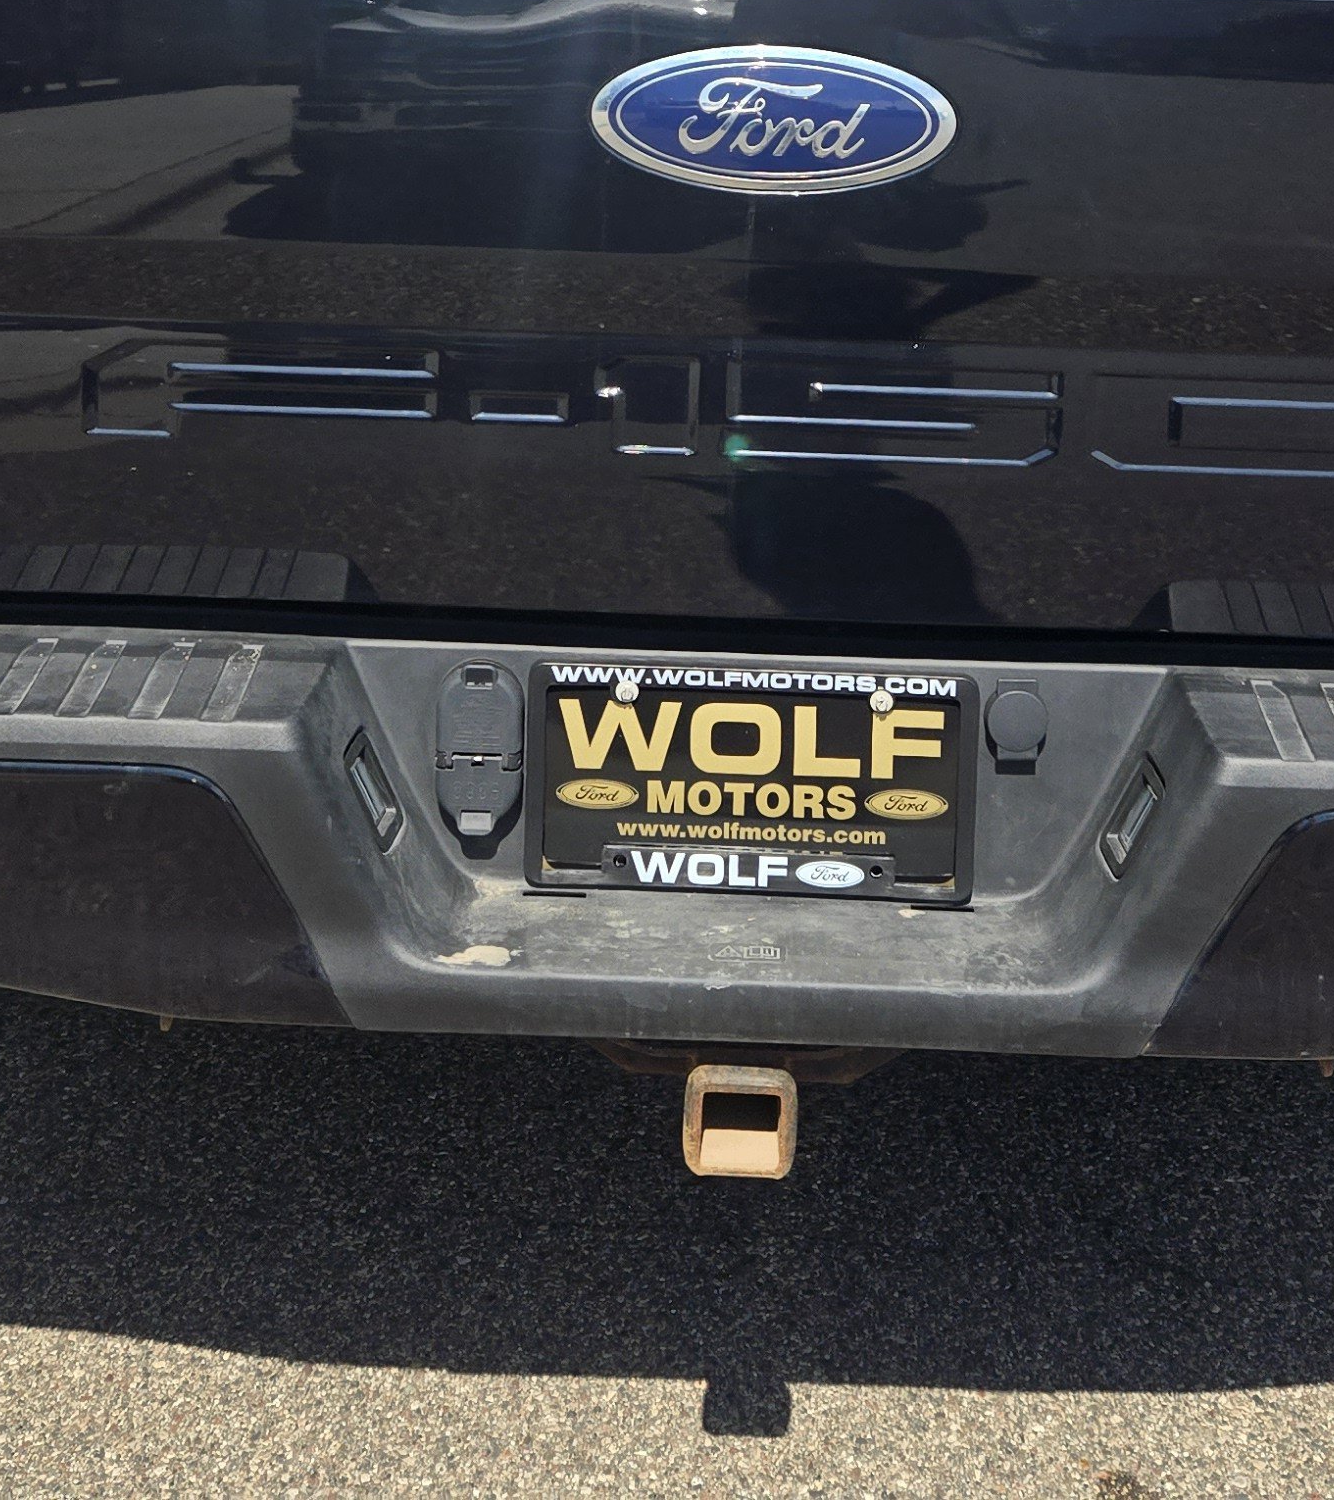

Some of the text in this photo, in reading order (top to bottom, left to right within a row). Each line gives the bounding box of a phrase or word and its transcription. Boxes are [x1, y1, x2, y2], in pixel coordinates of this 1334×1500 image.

[678, 76, 871, 159] Ford
[551, 665, 957, 697] WWW.WOLFMOTORS.COM
[558, 698, 946, 780] WOLF
[646, 780, 857, 821] MOTORS
[616, 821, 887, 846] www.wolfmotors.com
[630, 850, 789, 887] WOLF
